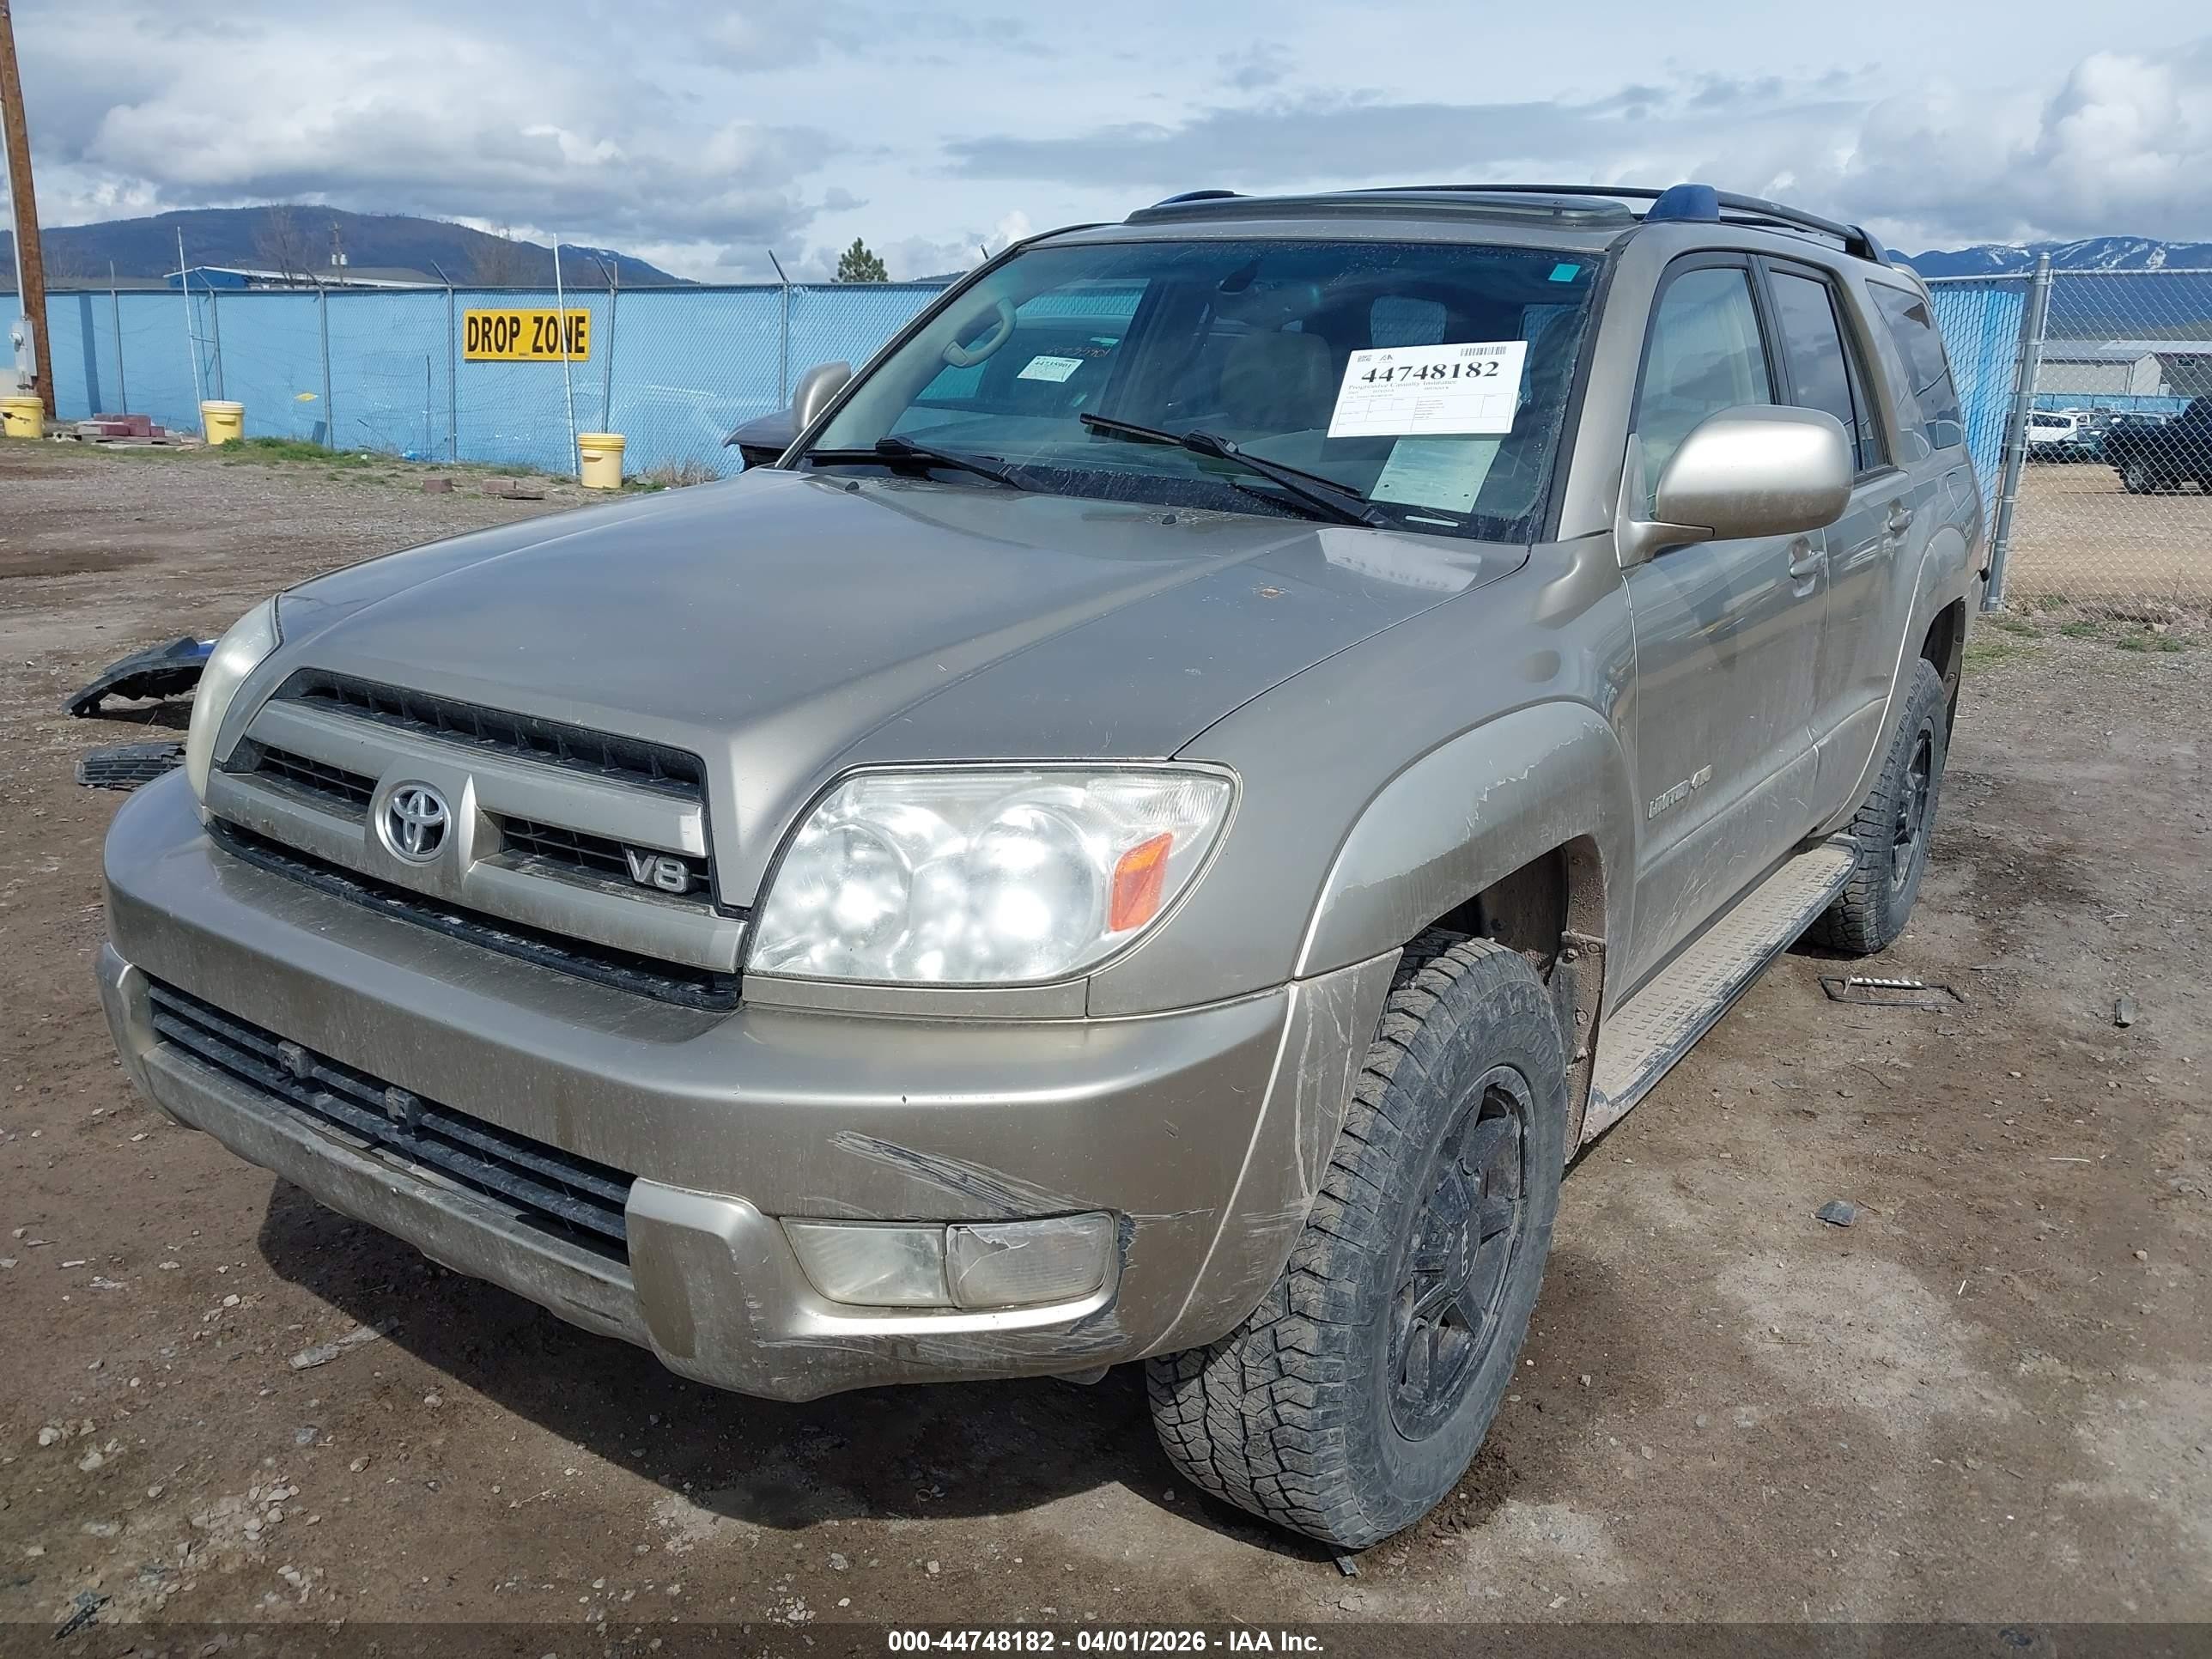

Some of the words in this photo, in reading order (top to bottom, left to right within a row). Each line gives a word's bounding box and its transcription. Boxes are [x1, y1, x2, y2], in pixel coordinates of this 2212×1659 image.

[467, 316, 520, 353] DROP
[532, 315, 586, 354] ZONE
[1361, 361, 1499, 383] 44748182
[625, 848, 689, 893] V8
